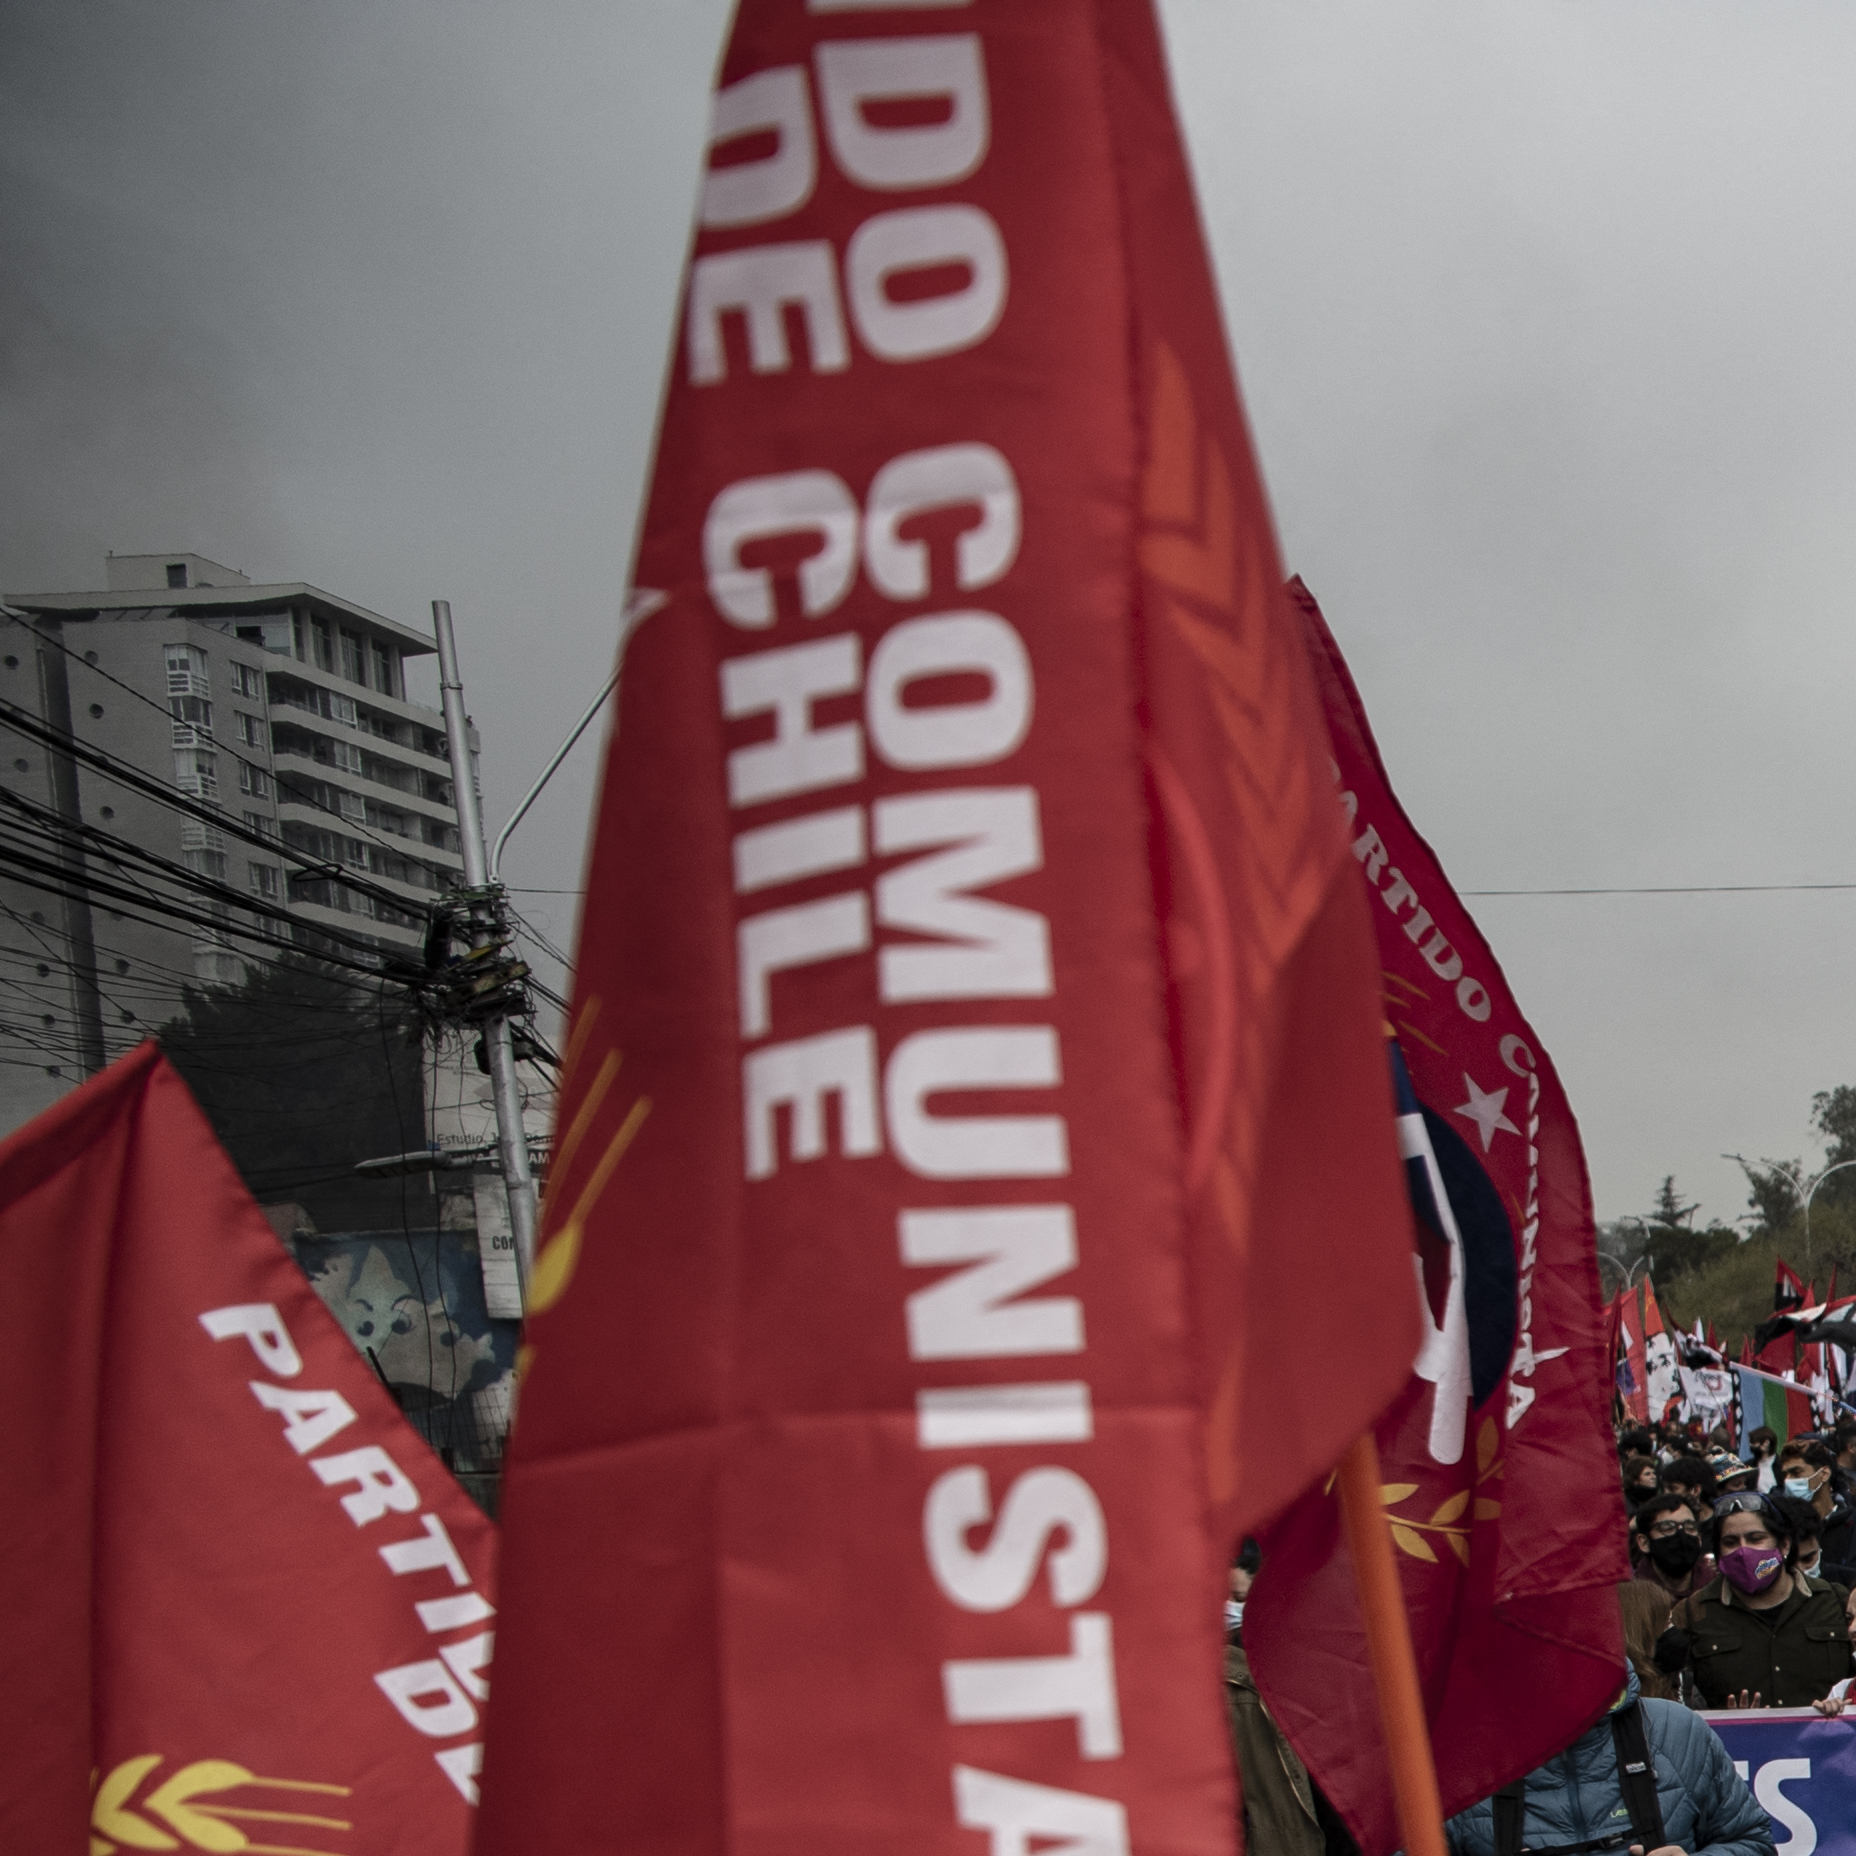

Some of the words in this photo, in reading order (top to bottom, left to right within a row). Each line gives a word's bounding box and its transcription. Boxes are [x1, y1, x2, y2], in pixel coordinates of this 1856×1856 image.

[687, 60, 854, 390] DE
[803, 0, 1012, 364] DO
[702, 466, 886, 1184] CHILE
